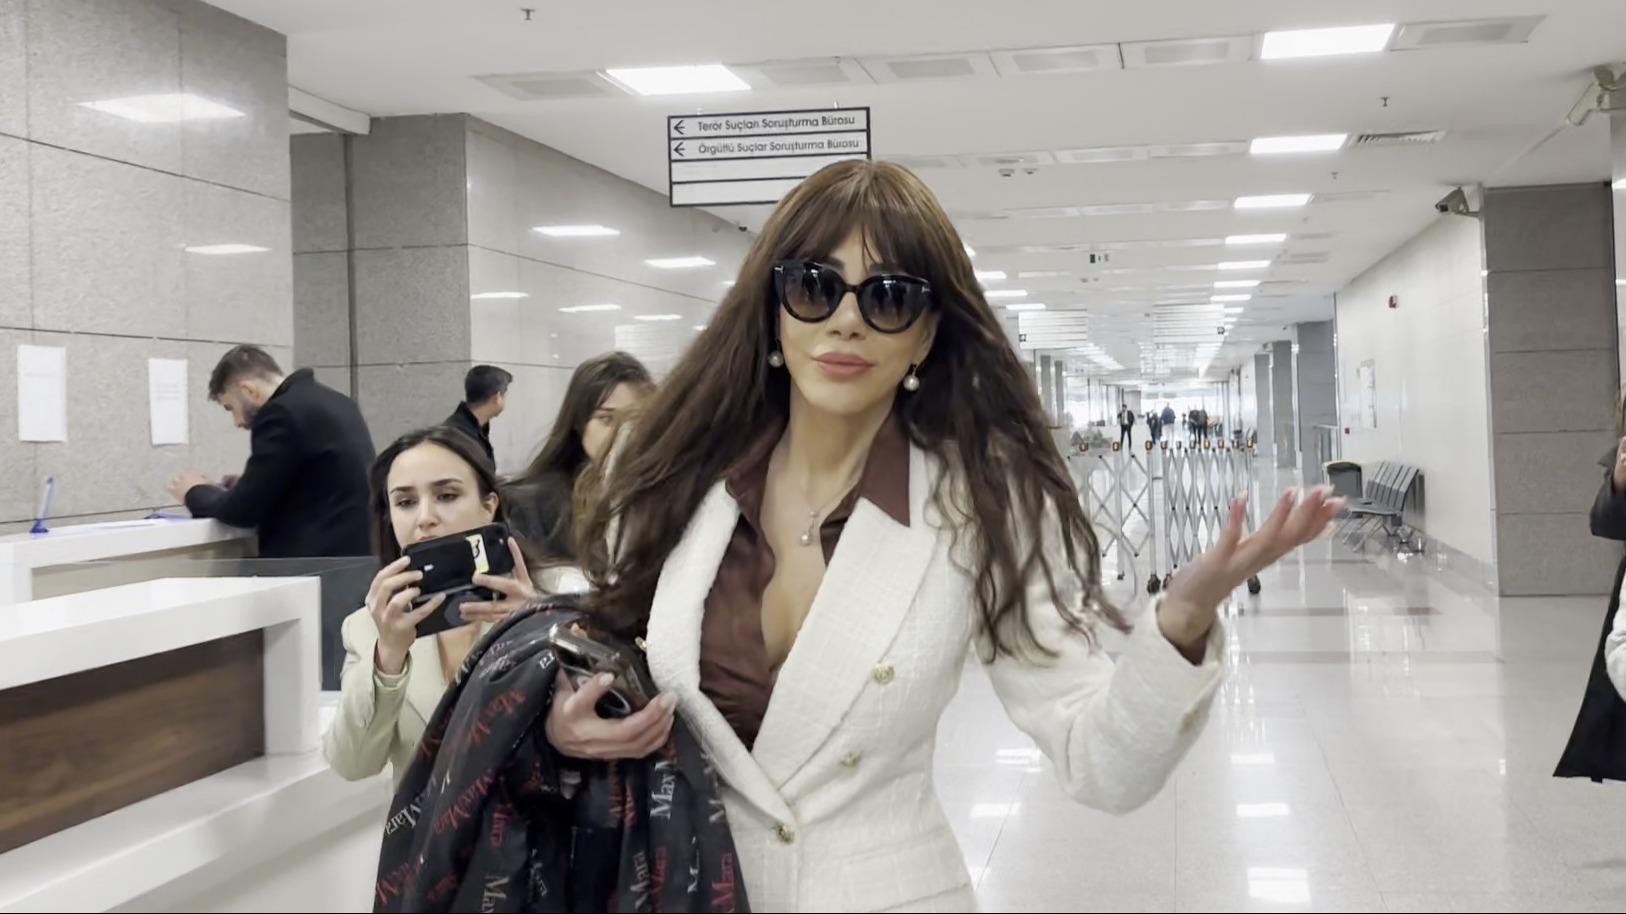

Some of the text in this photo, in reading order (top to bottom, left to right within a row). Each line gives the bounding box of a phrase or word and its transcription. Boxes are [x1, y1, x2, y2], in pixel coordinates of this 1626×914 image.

[697, 120, 722, 131] Terör
[762, 117, 819, 130] Soruşturma
[822, 115, 855, 126] Bürosu
[737, 142, 767, 153] Suçlar
[769, 141, 825, 152] Soruşturma
[827, 139, 859, 149] Bürosu
